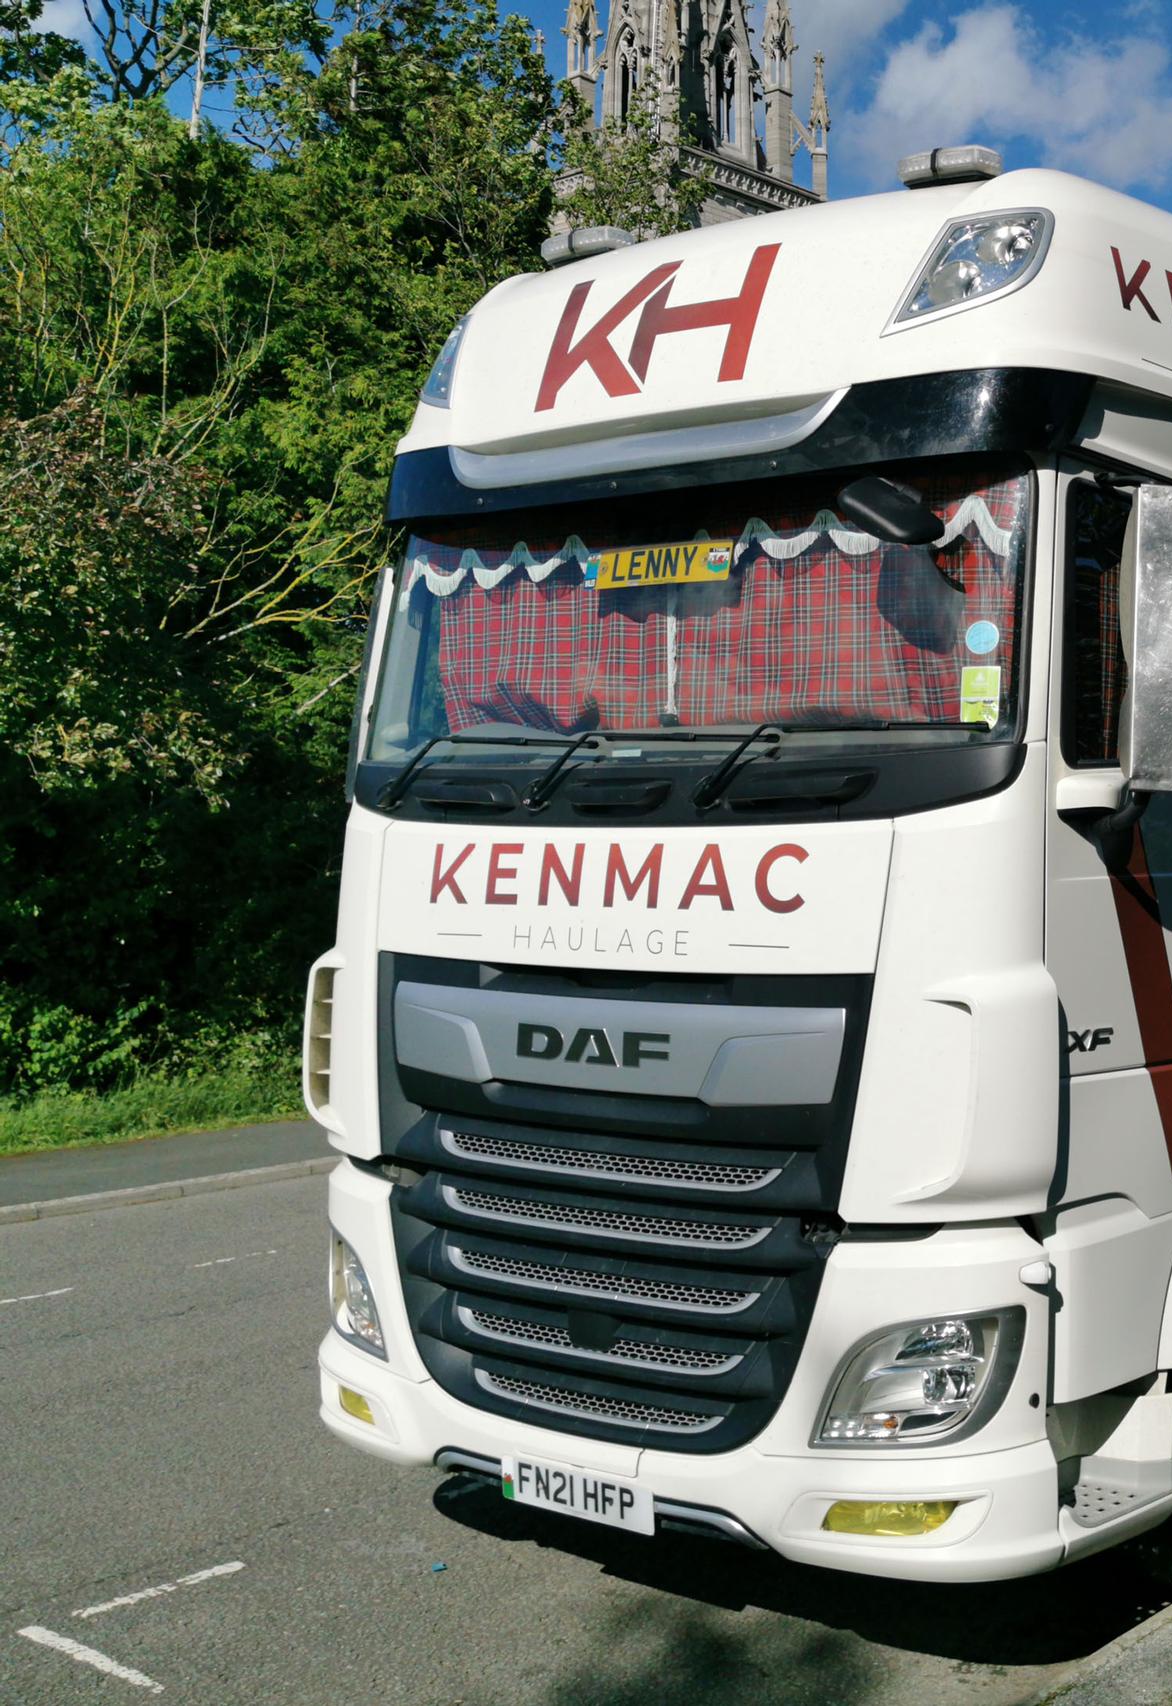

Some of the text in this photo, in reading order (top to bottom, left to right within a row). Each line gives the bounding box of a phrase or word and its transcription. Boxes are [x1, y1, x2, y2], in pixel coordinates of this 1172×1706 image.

[534, 243, 782, 412] KH
[611, 546, 699, 582] LENNY
[429, 843, 810, 914] KENMAC
[512, 925, 691, 956] HAULAGE
[516, 1024, 671, 1068] DAF
[1067, 1027, 1114, 1053] XF
[518, 1462, 635, 1520] FN21 HFP
